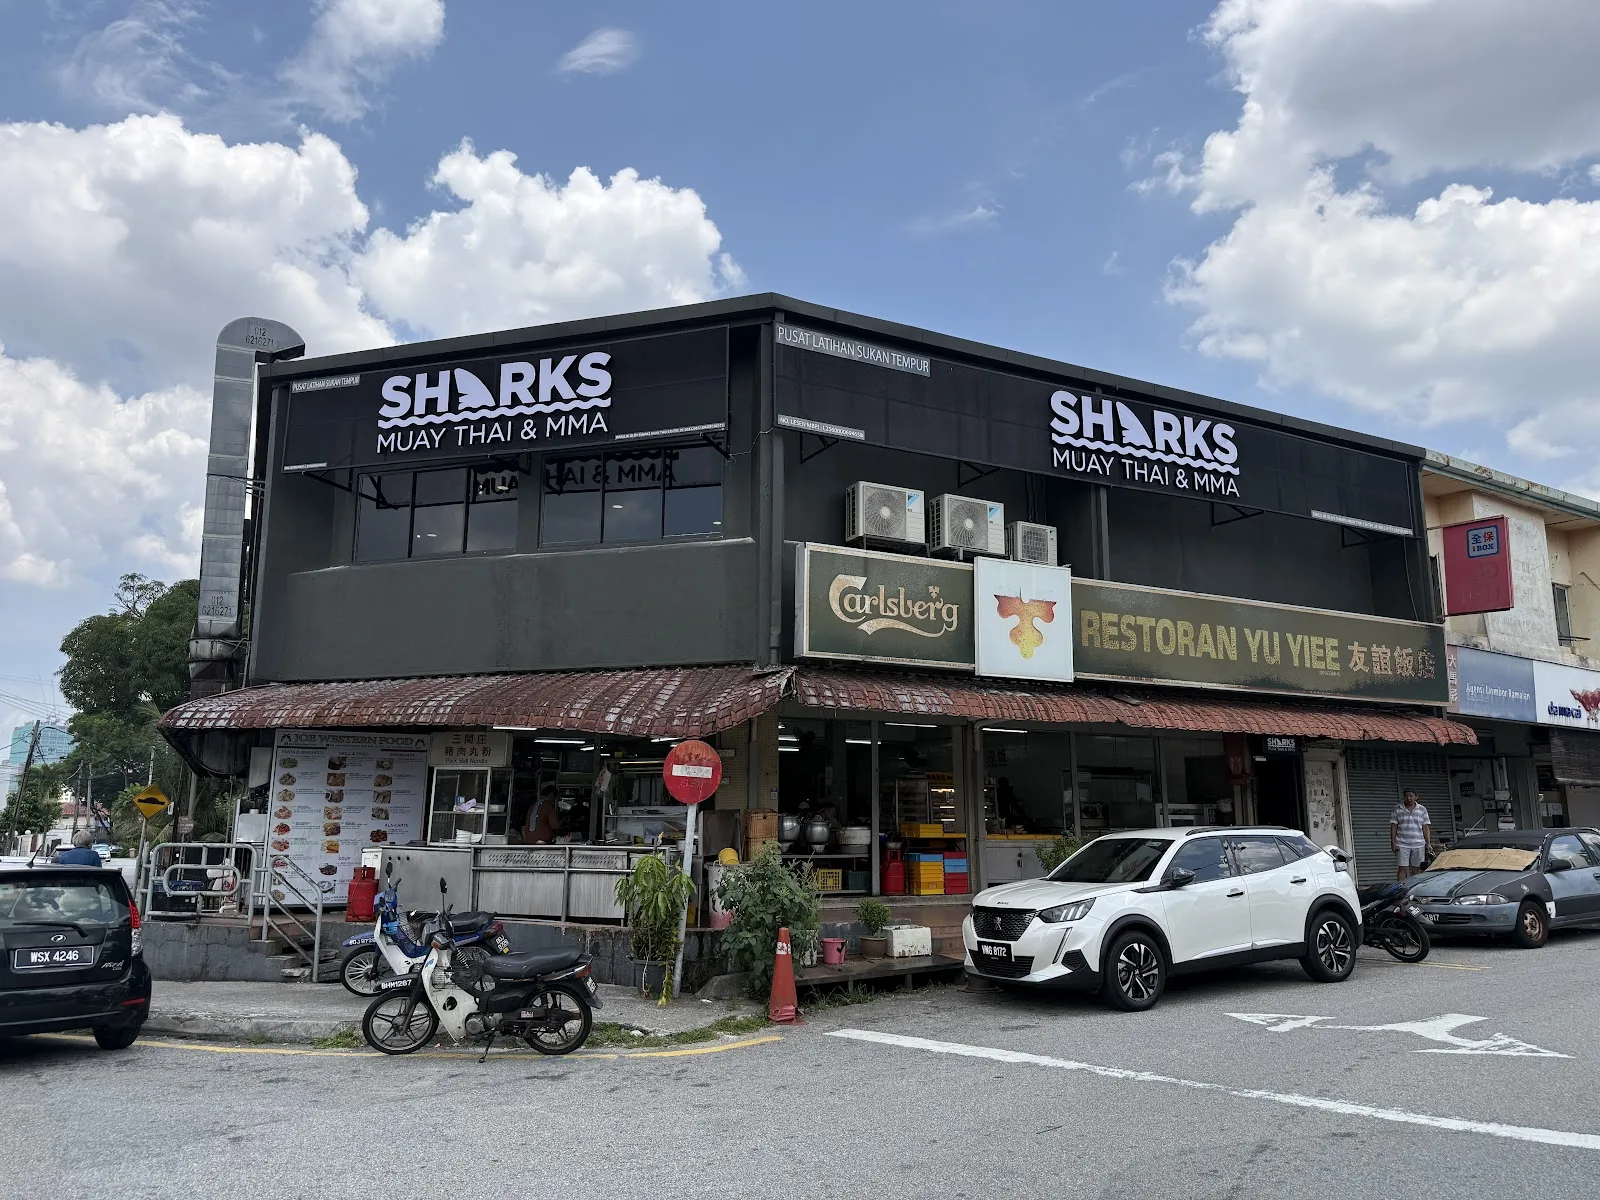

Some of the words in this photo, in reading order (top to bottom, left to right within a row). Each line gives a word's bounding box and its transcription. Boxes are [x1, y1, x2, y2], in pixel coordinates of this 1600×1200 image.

[779, 326, 811, 346] PUSAT
[811, 334, 856, 357] LATIHAN
[857, 345, 890, 364] SUKAN
[891, 353, 929, 373] TEMPUR
[376, 427, 446, 454] MUAY
[454, 420, 512, 446] THAI
[520, 419, 537, 440] &
[546, 412, 608, 438] MMA
[1053, 447, 1115, 476] MUAY
[1121, 458, 1169, 486] THAI
[1175, 468, 1189, 489] &
[1194, 471, 1240, 498] MMA
[1471, 531, 1494, 545] 全保
[829, 574, 959, 637] Carlsberg
[1080, 609, 1238, 661] RESTORAN
[1243, 629, 1281, 665] YU
[1285, 632, 1341, 671] YIEE
[293, 733, 316, 743] JOE
[317, 734, 378, 745] WESTERN
[379, 736, 414, 746] FOOD
[30, 951, 50, 963] WSX
[53, 950, 79, 961] 4246
[993, 946, 1007, 957] 8172
